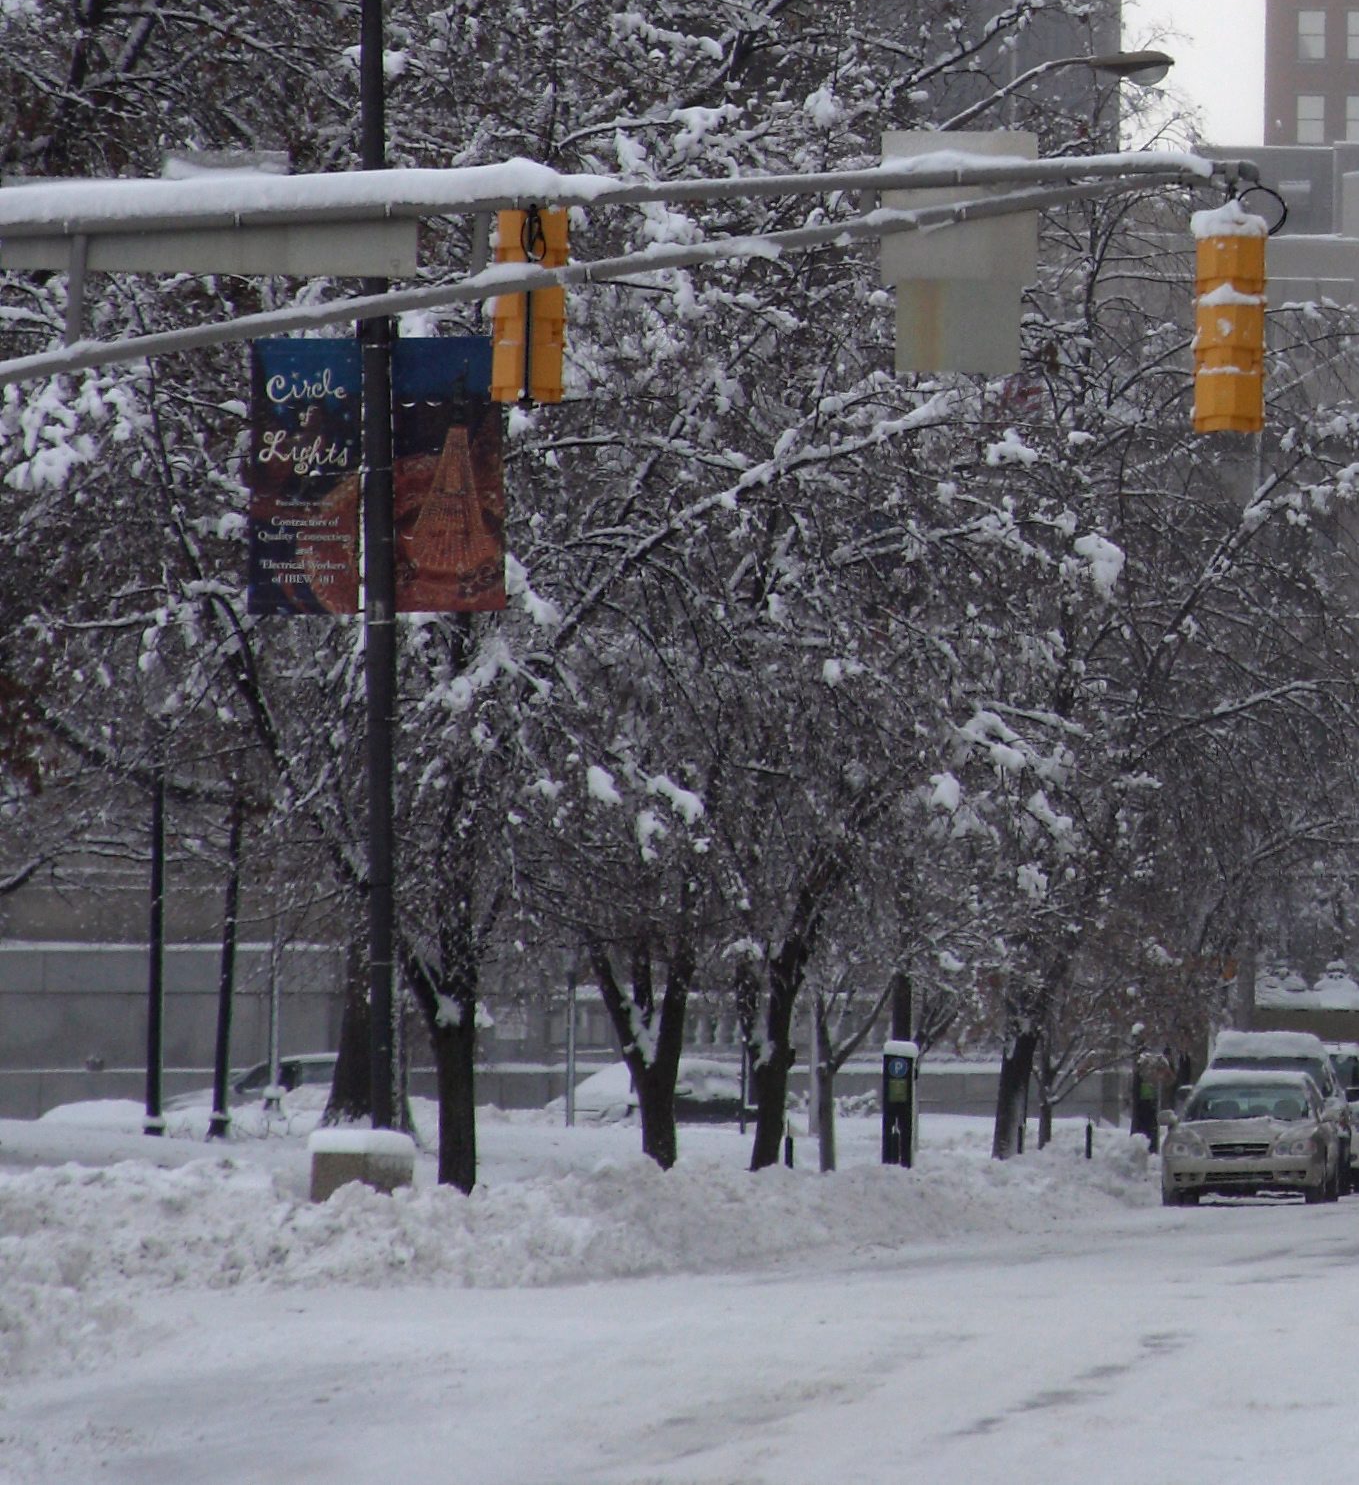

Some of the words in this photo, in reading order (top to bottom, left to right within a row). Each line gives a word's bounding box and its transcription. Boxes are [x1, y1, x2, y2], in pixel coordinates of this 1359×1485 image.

[266, 368, 347, 403] Circle
[299, 405, 318, 427] of
[259, 430, 348, 474] Lights
[258, 527, 293, 543] Quality
